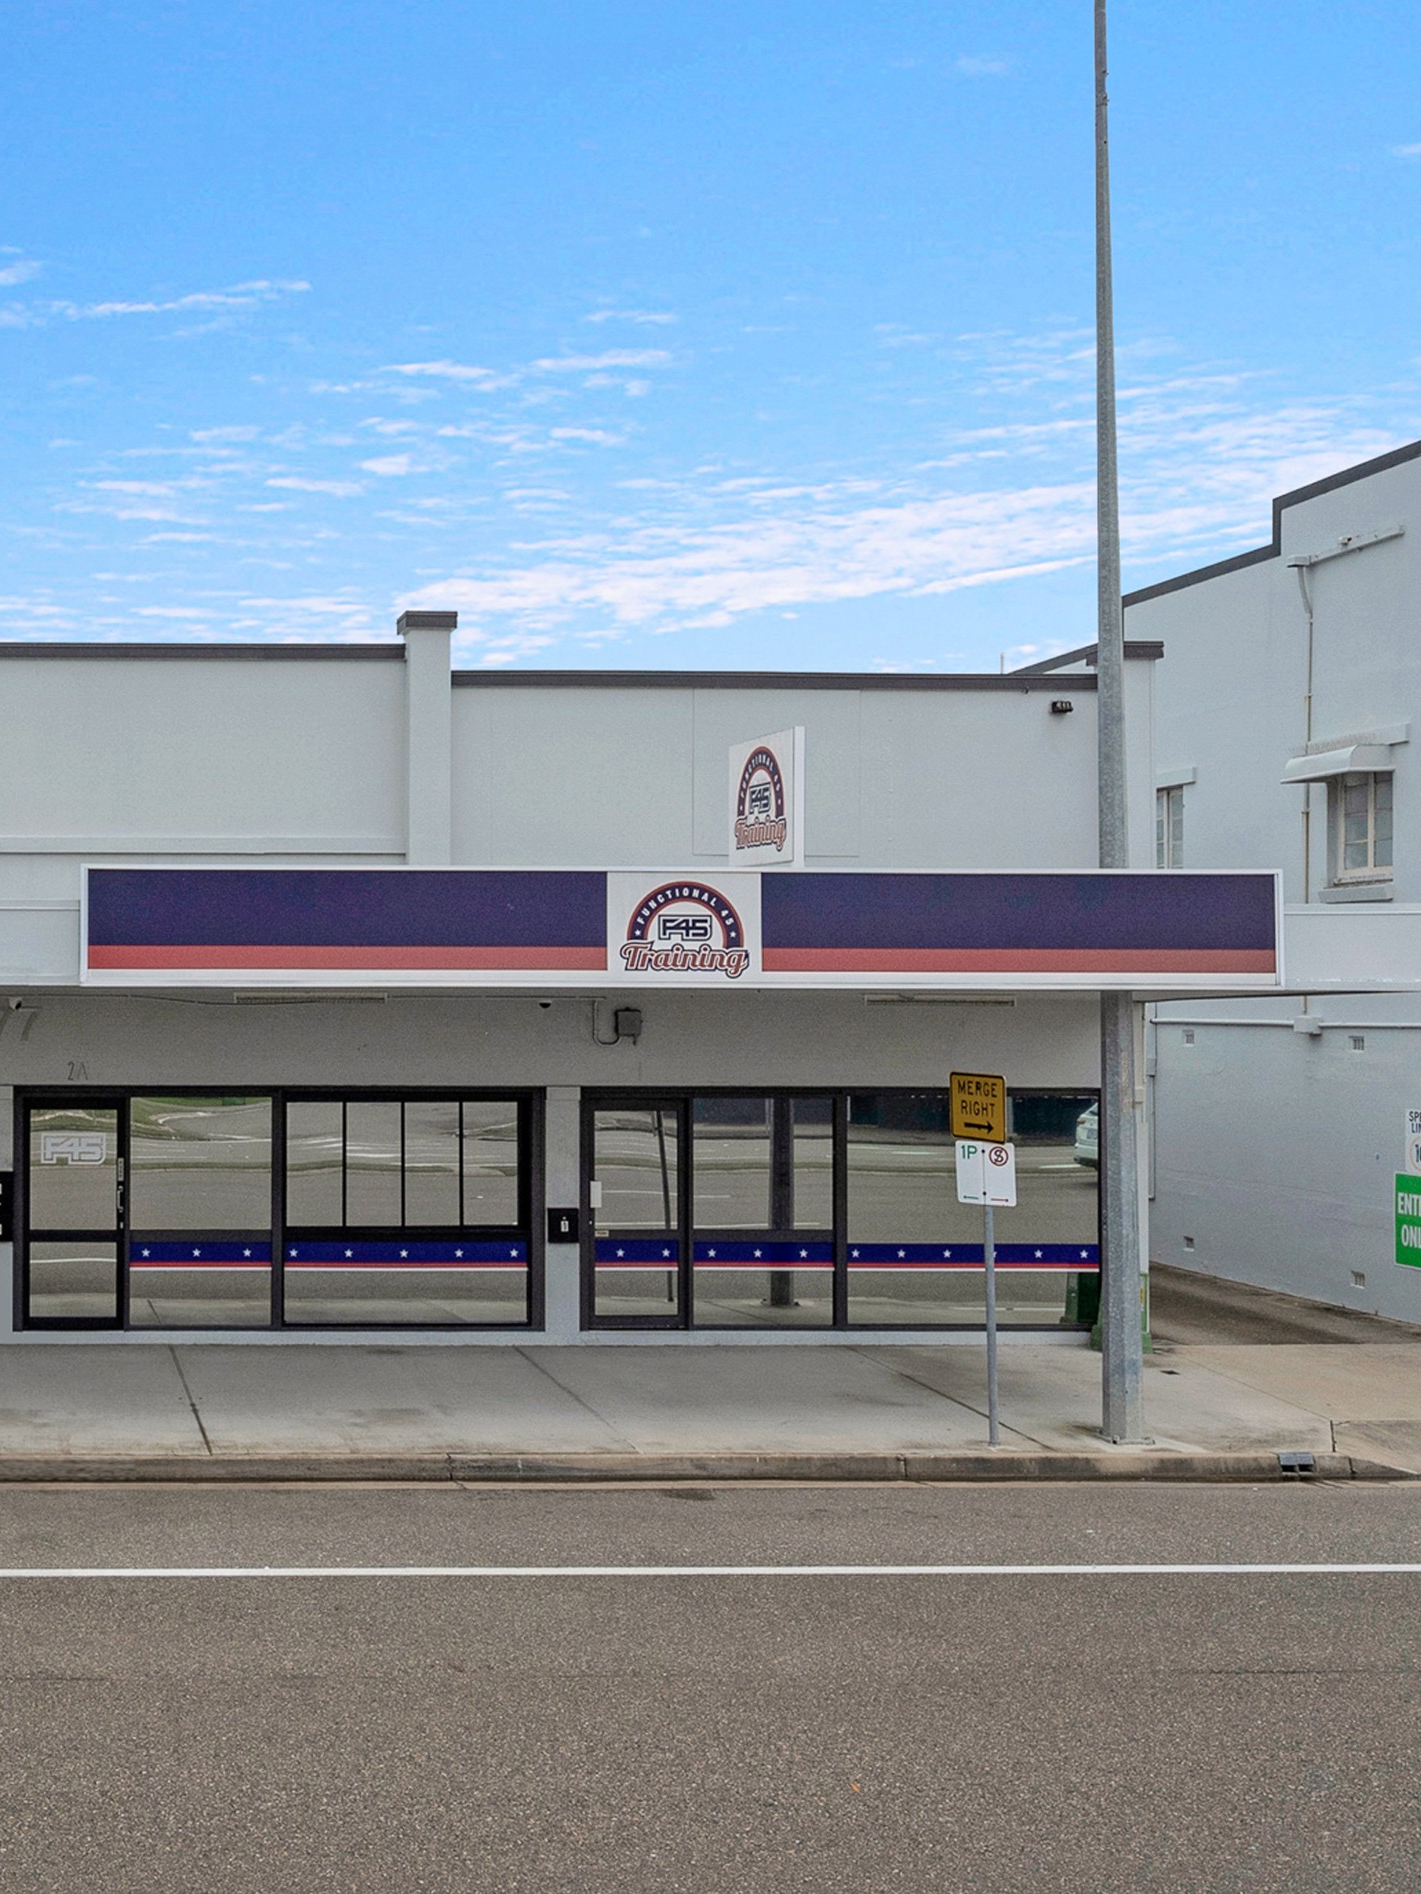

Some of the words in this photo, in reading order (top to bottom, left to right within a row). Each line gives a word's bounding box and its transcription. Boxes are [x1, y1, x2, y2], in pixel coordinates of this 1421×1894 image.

[748, 782, 772, 815] F45
[735, 816, 787, 852] Training
[636, 887, 717, 925] FUNCTIONAL
[720, 909, 735, 926] 45
[658, 914, 713, 942] F45
[620, 942, 750, 979] Training
[66, 1060, 89, 1081] 2A
[957, 1079, 998, 1098] MERGE
[960, 1099, 996, 1118] RIGHT
[1409, 1110, 1421, 1122] SP
[42, 1133, 106, 1165] F45
[960, 1145, 978, 1159] 1P
